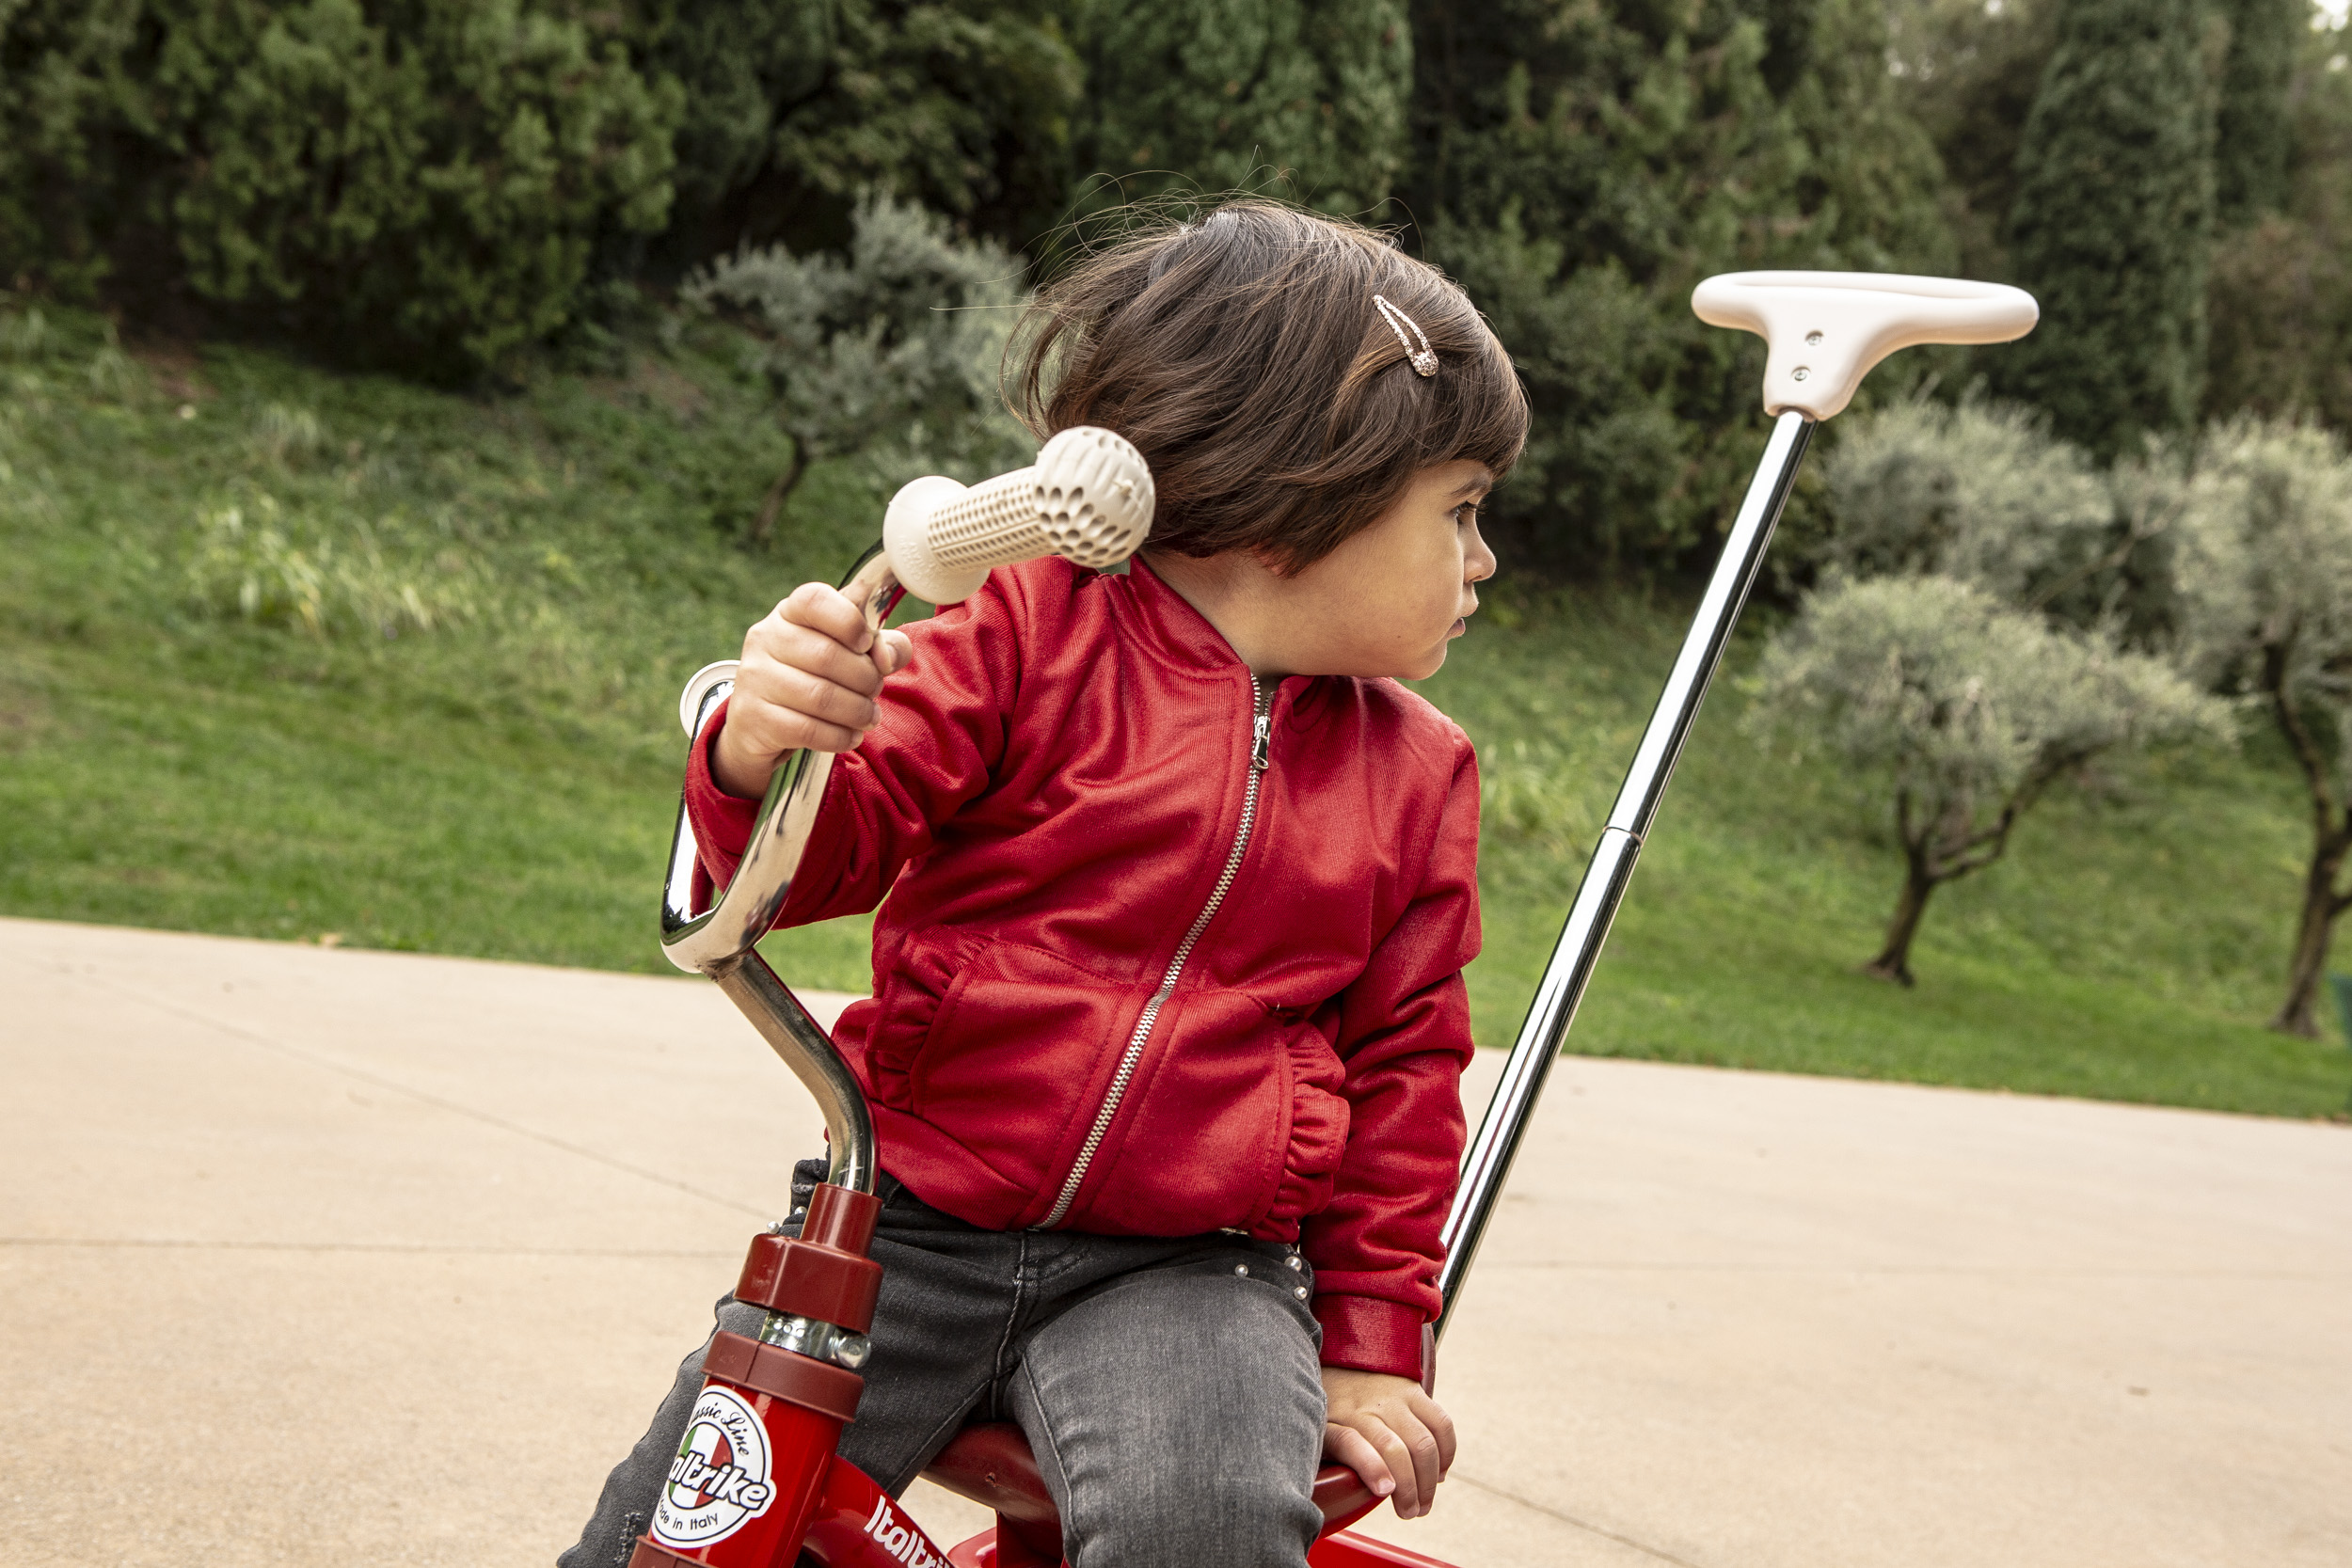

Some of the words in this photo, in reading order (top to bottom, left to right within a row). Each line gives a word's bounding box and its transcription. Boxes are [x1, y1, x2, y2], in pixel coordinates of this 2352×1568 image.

[690, 1402, 722, 1423] assic
[721, 1412, 750, 1457] Line
[668, 1449, 771, 1511] altrike
[673, 1517, 683, 1530] in
[691, 1513, 718, 1530] Italy
